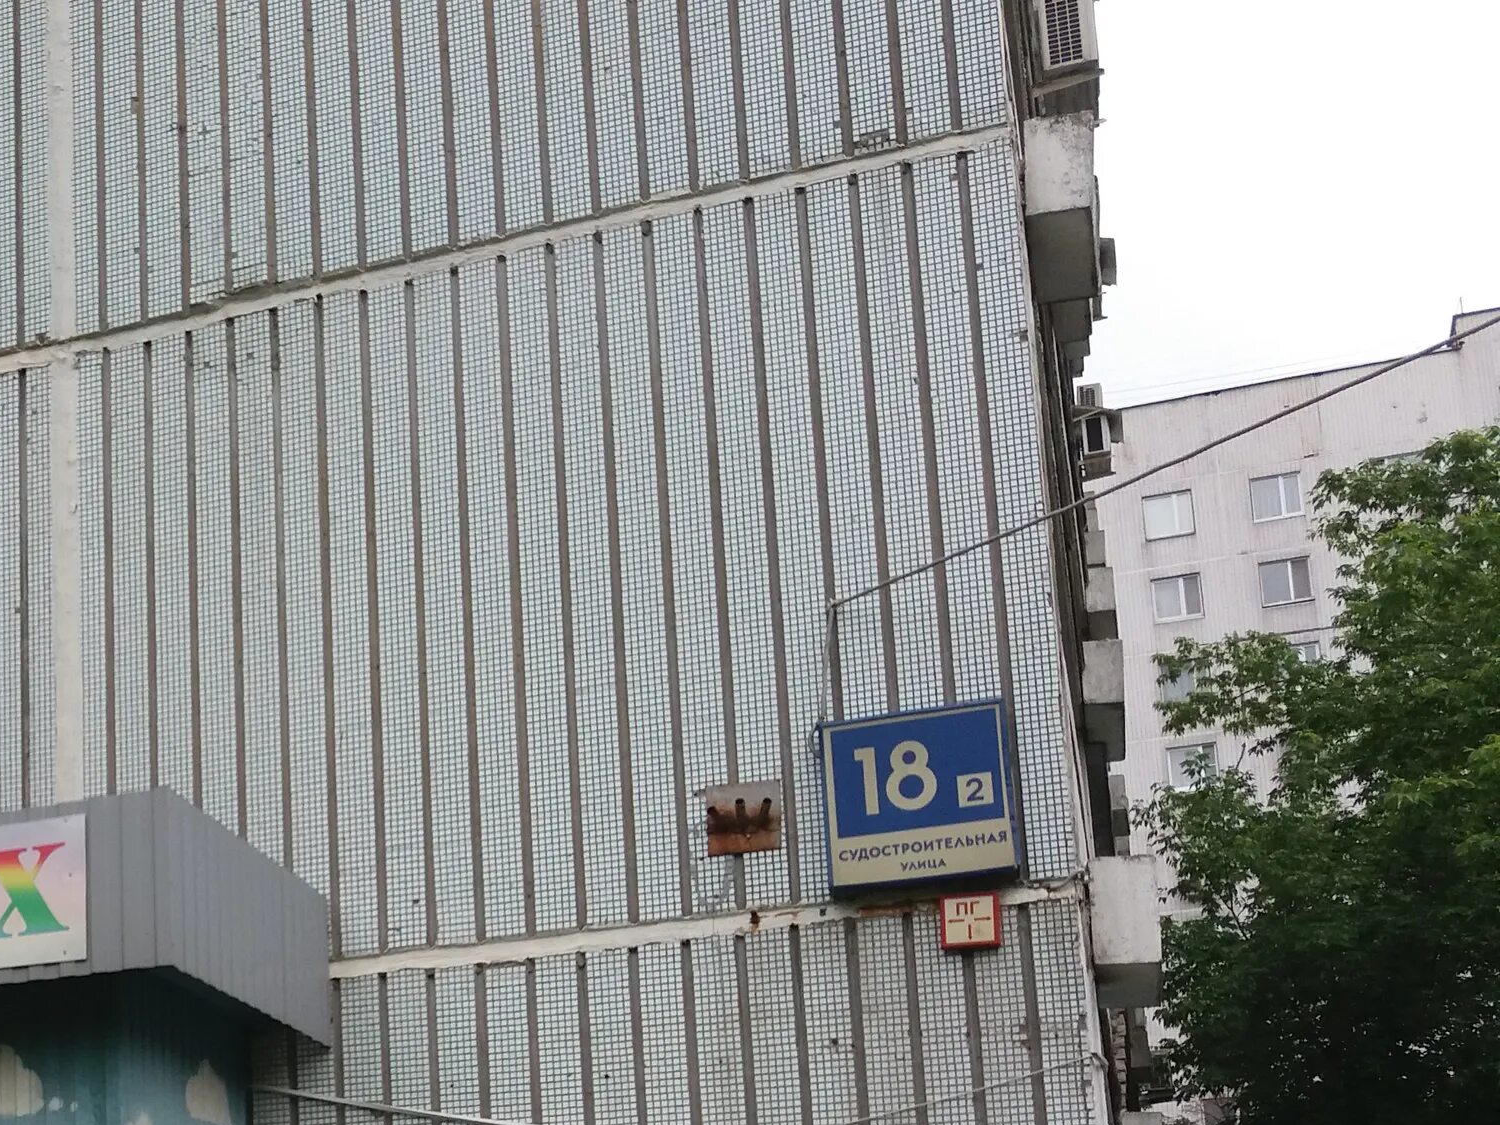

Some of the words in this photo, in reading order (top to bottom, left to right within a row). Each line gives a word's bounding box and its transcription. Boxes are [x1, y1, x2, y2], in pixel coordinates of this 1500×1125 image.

[853, 739, 938, 816] 18
[965, 777, 985, 803] 2
[838, 830, 1008, 862] СУДОСТРОИТЕЛЬНАЯ
[900, 857, 947, 872] УЛИЦА
[955, 901, 980, 916] ПГ
